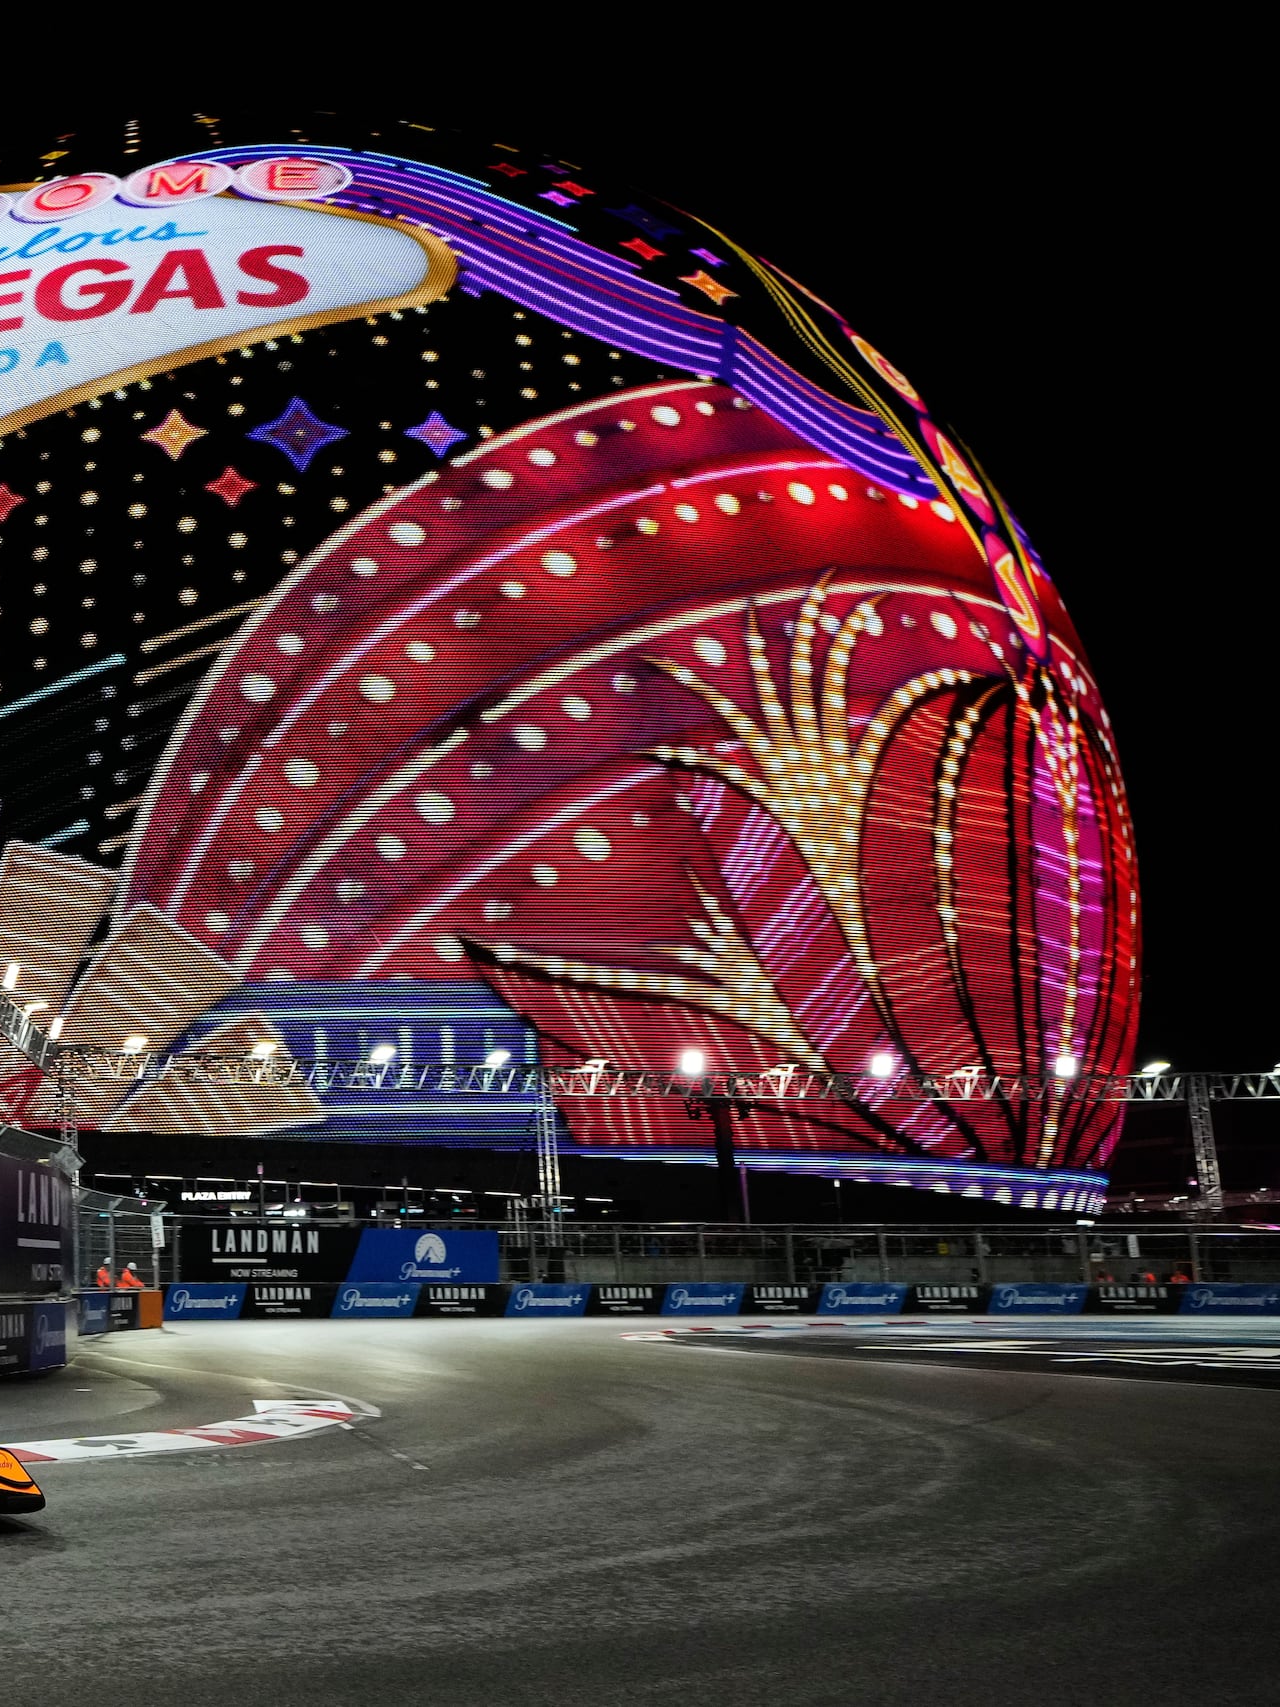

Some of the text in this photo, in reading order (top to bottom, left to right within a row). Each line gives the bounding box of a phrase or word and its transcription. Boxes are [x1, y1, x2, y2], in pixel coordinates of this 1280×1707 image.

[17, 1170, 61, 1227] LAND
[181, 1191, 217, 1201] PLAZA
[210, 1229, 320, 1254] LANDMAN
[229, 1268, 250, 1278] NOW
[254, 1287, 312, 1300] LANDMAN
[429, 1288, 486, 1300] LANDMAN
[598, 1287, 653, 1300] LANDMAN
[752, 1286, 809, 1299] LANDMAN
[915, 1286, 979, 1299] LANDMAN
